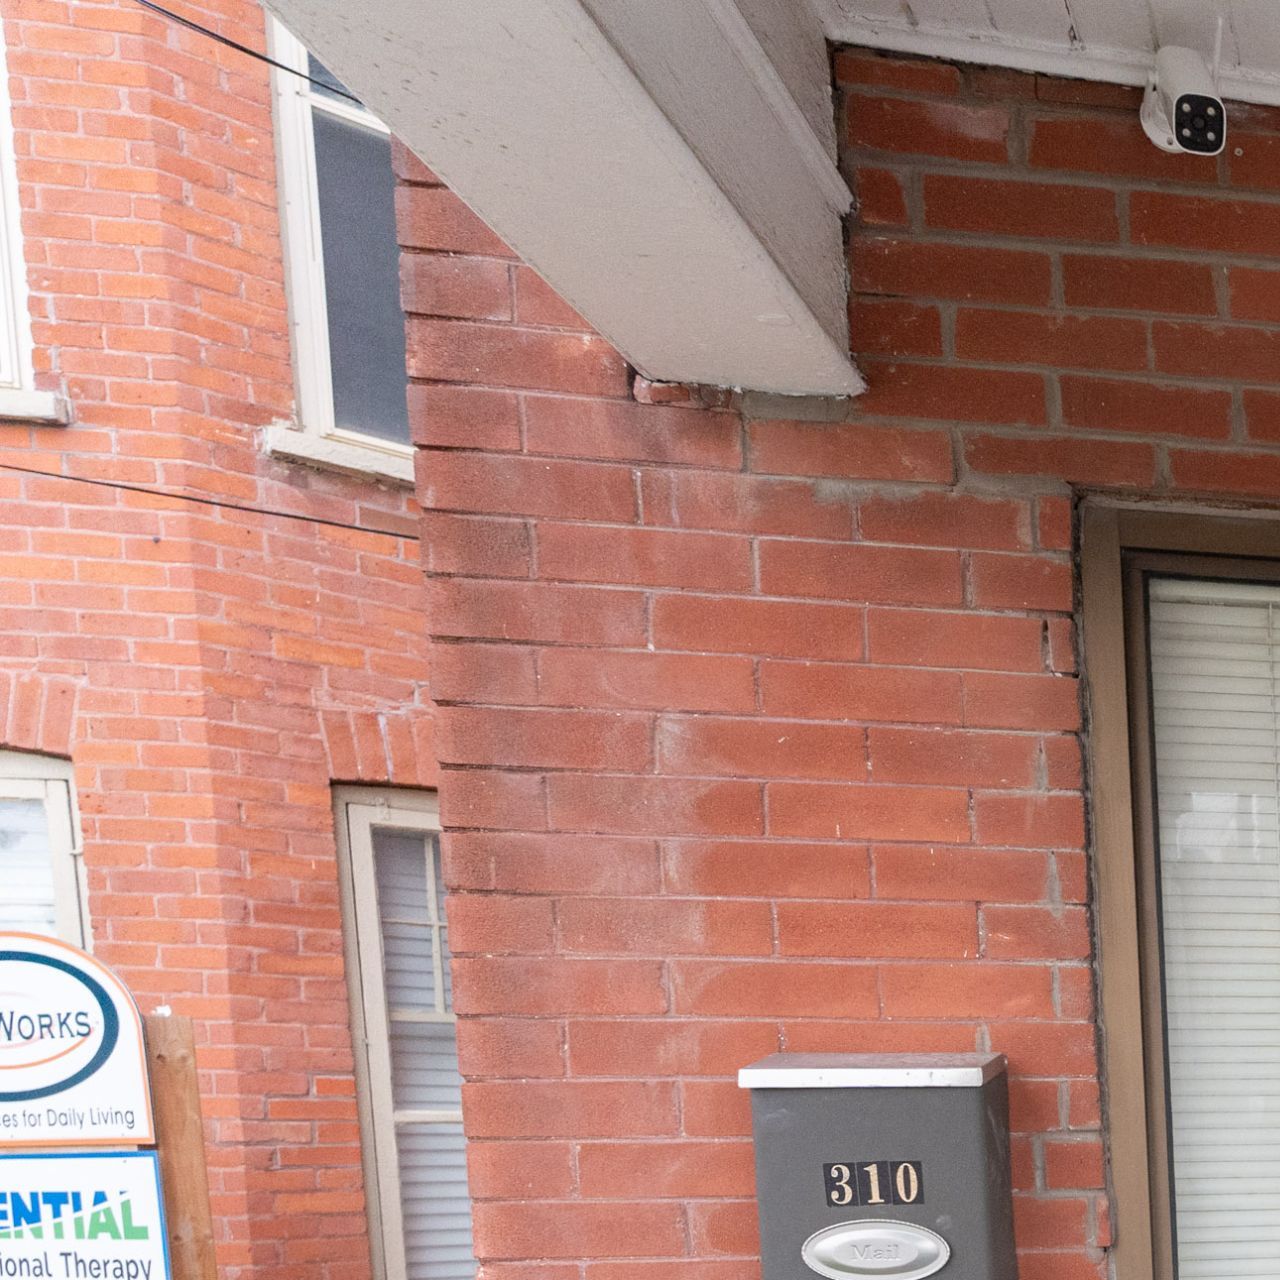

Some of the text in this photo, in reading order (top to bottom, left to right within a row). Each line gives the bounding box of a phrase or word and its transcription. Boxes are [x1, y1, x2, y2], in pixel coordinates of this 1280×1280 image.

[22, 1109, 41, 1127] for
[46, 1108, 85, 1129] Daily
[90, 1107, 135, 1129] Living
[831, 1163, 919, 1205] 310
[849, 1243, 901, 1261] Mail
